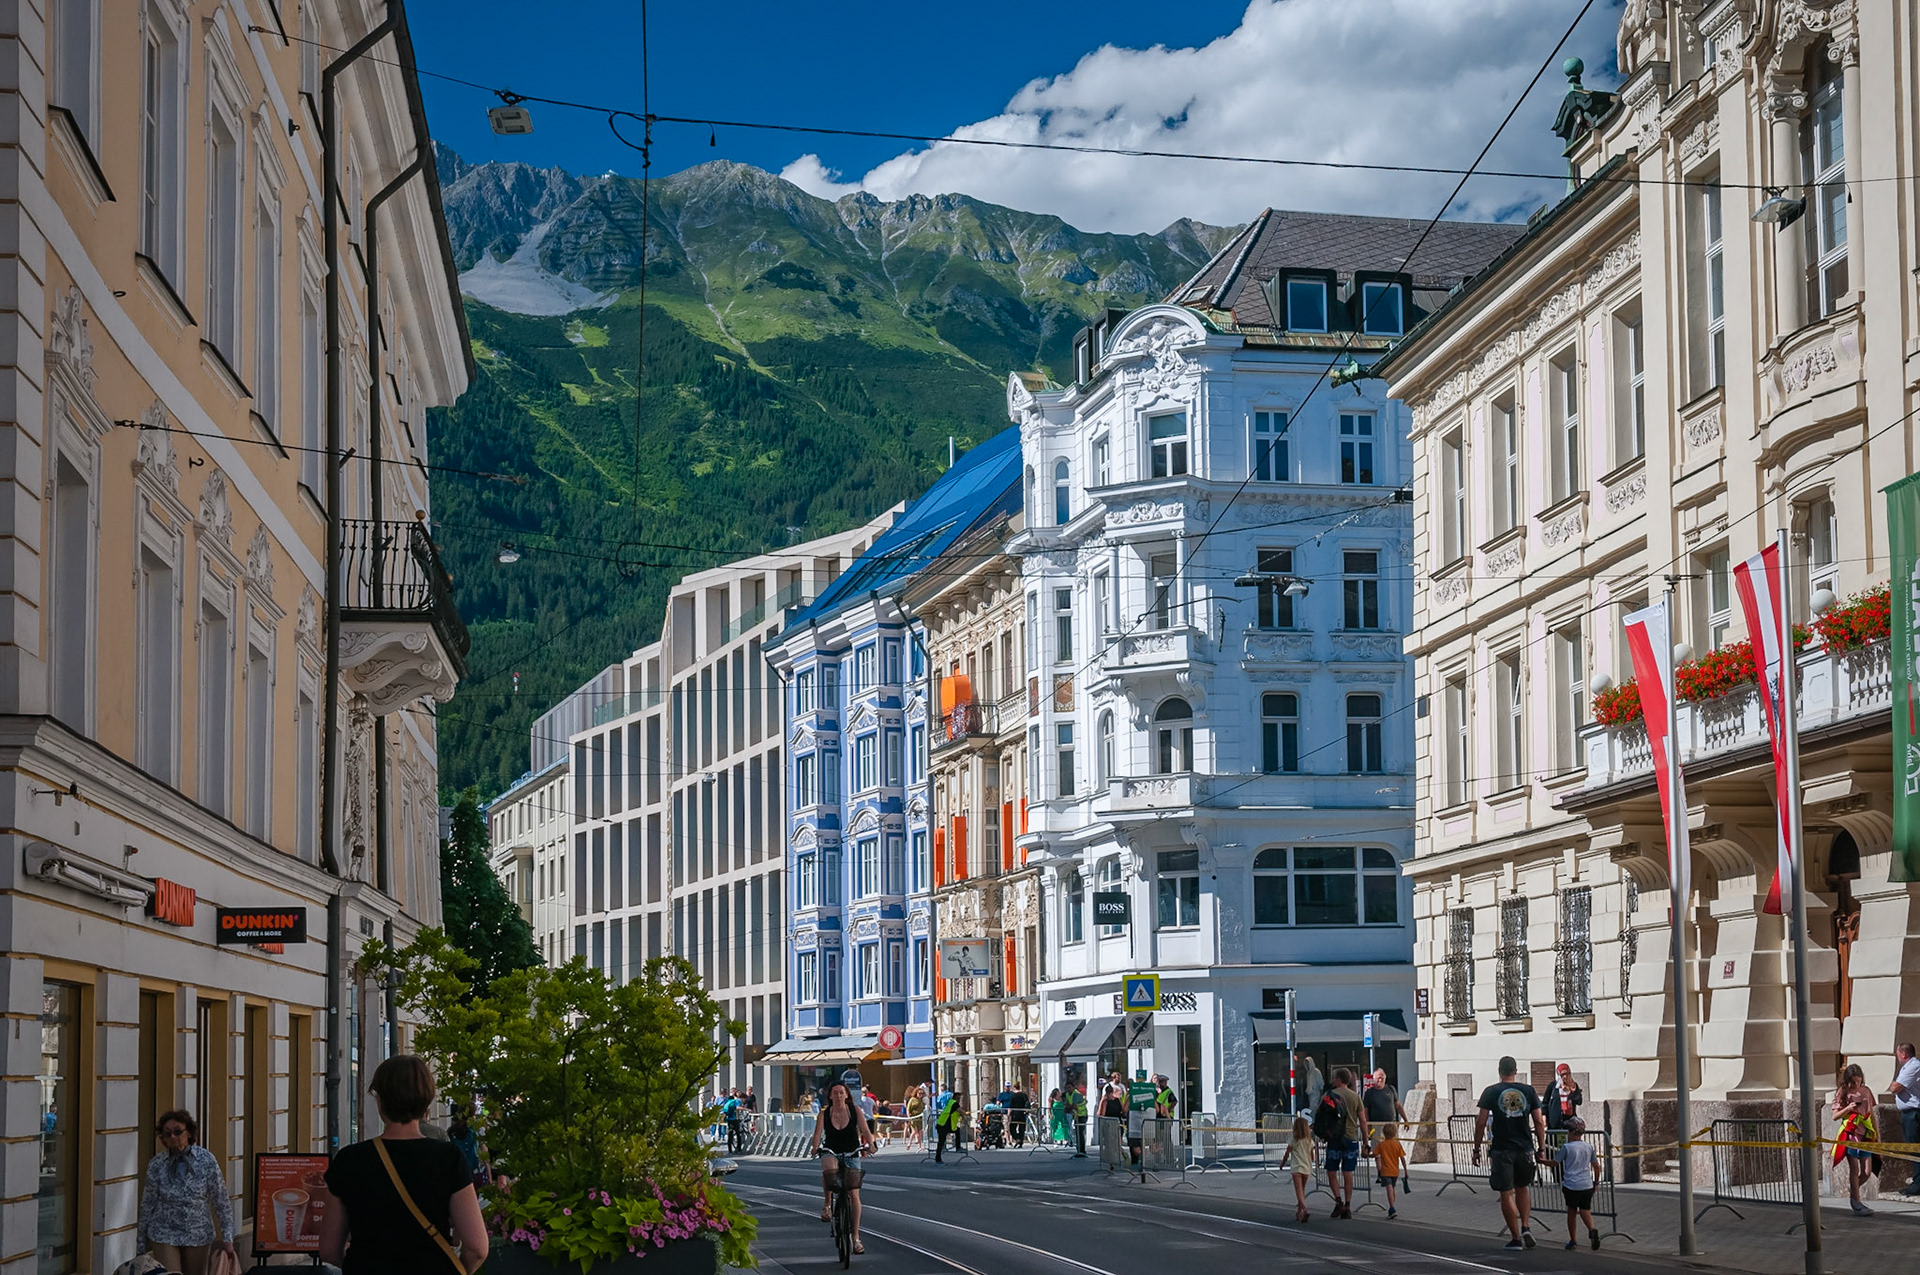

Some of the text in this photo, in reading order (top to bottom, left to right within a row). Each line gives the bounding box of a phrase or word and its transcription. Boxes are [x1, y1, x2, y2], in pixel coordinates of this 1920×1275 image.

[1099, 903, 1124, 911] BOSS
[222, 914, 299, 929] DUNKIN'
[1129, 1037, 1152, 1048] Zone
